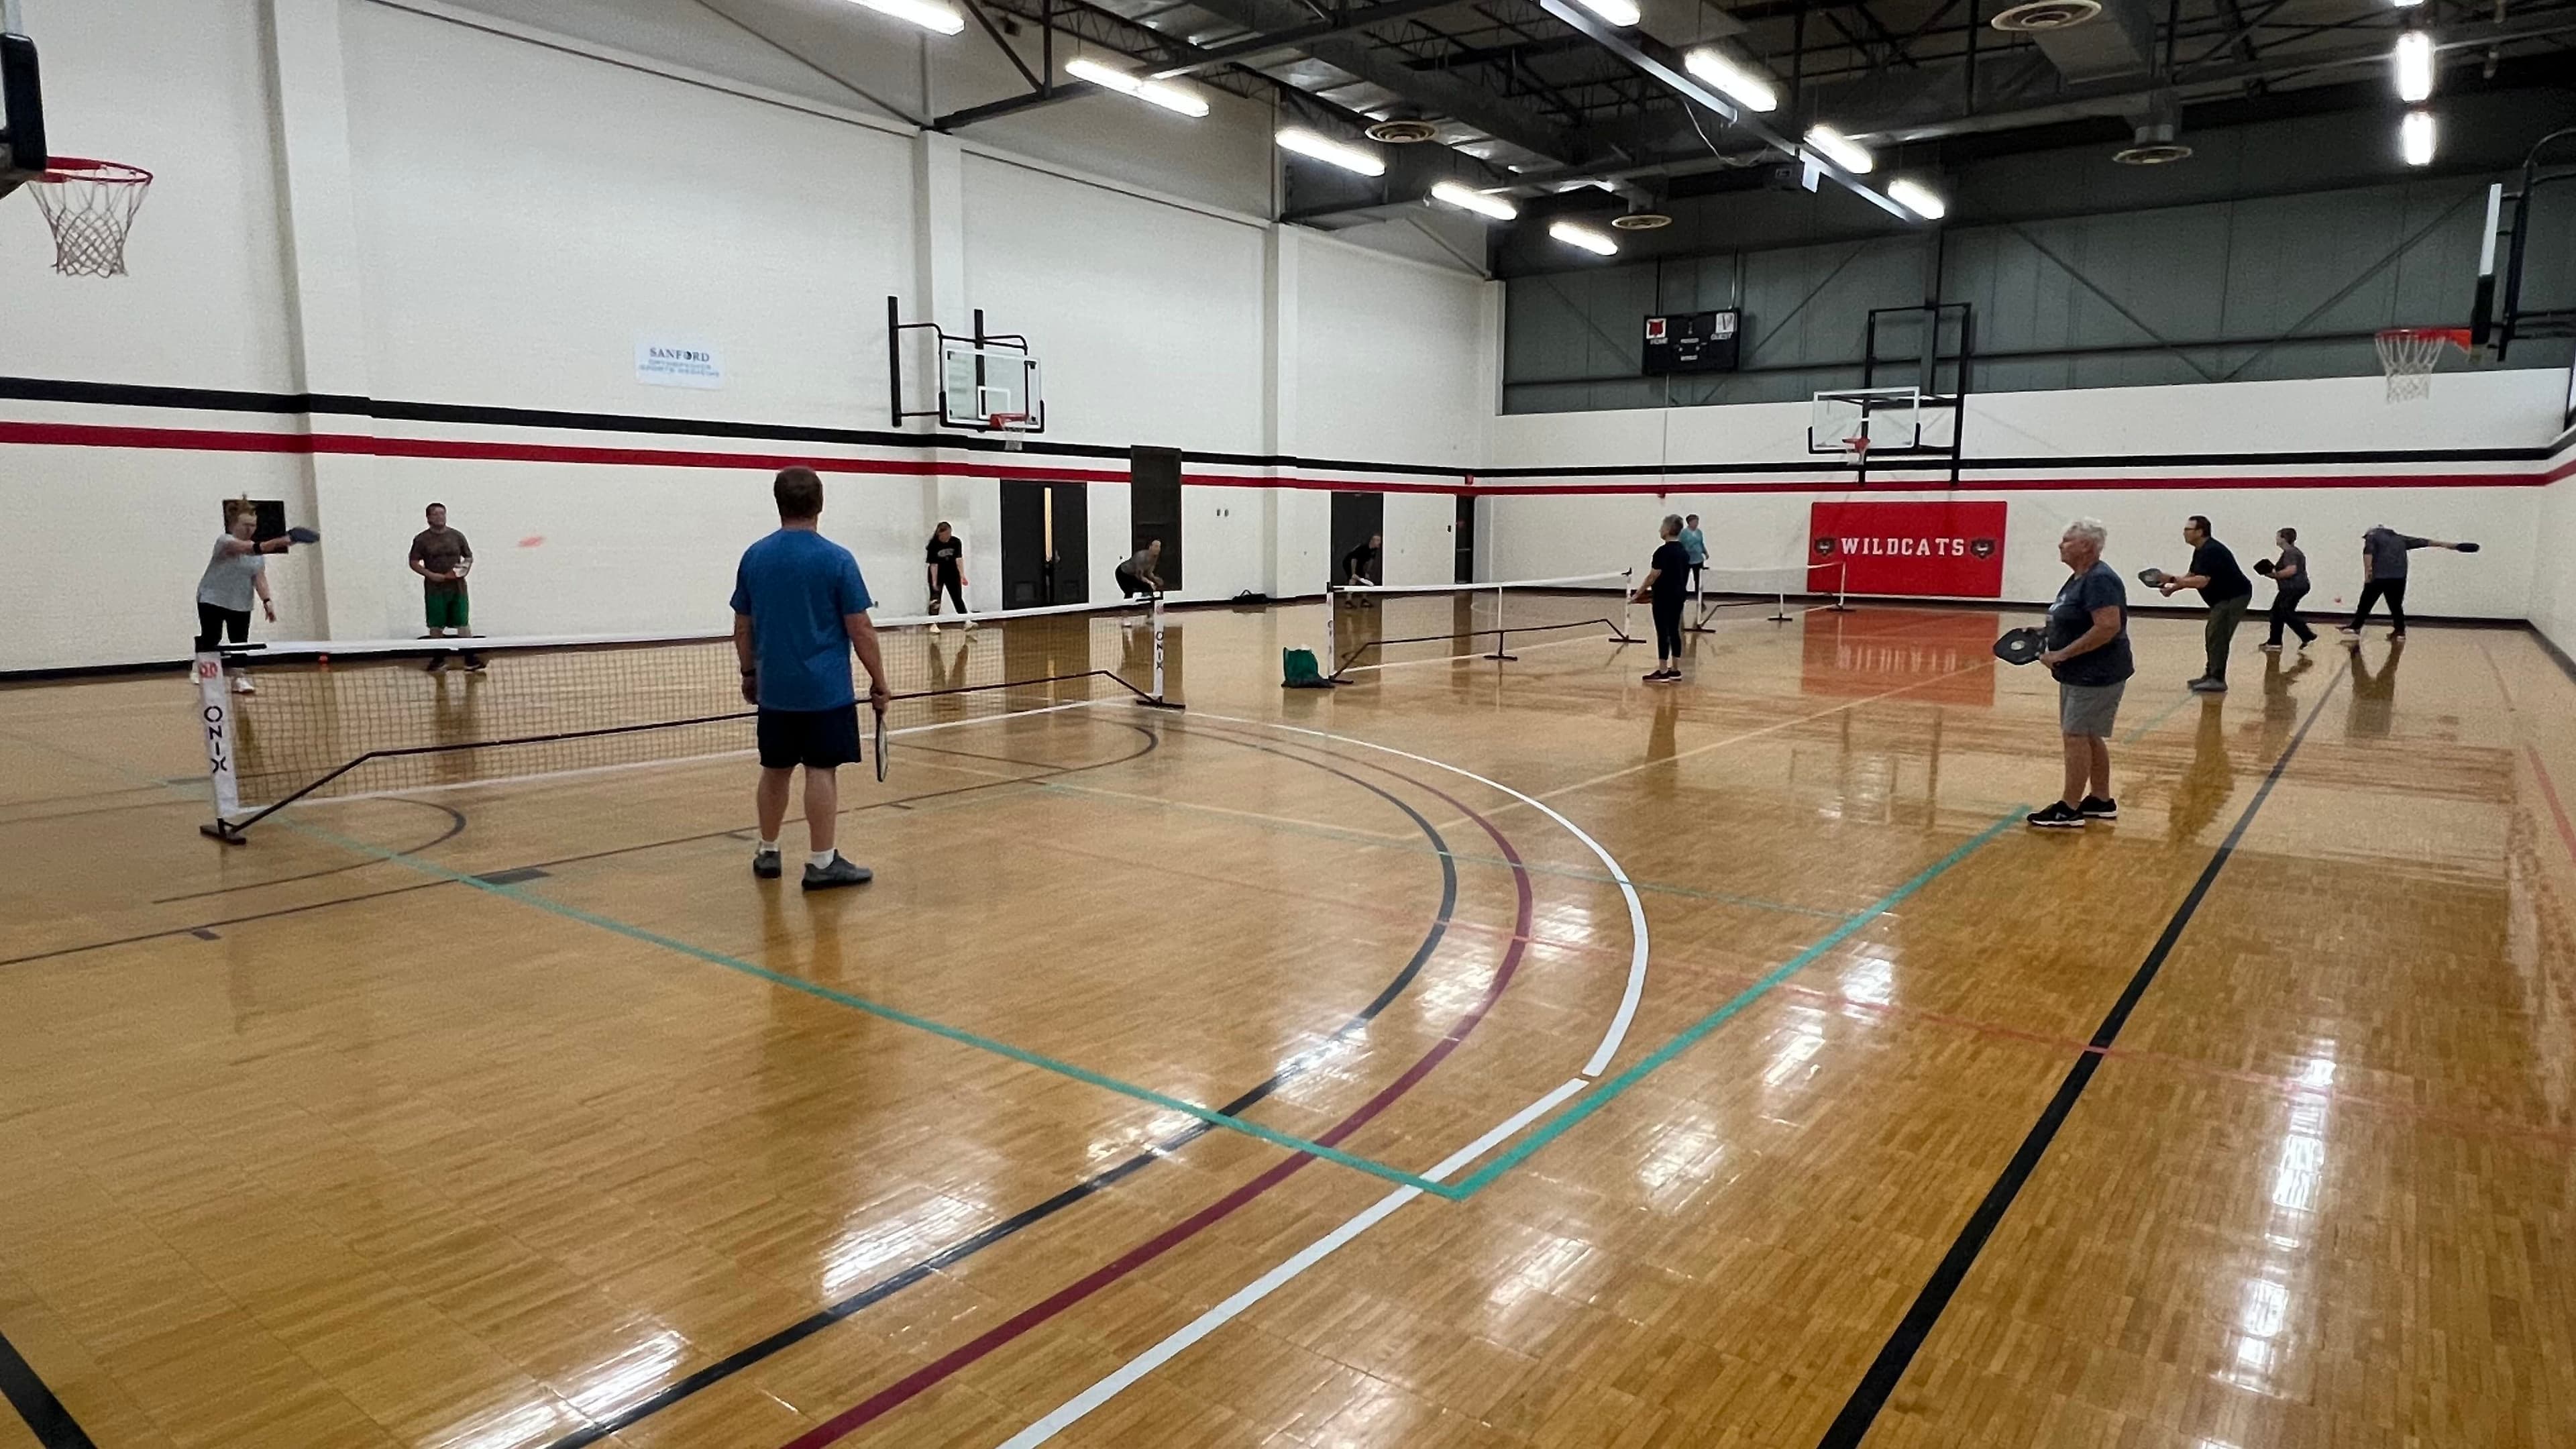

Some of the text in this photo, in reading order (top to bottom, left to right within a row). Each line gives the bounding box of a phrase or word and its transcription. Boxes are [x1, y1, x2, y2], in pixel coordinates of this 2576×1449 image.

[649, 348, 710, 362] SANFORD
[1841, 538, 1964, 556] WILDCATS
[204, 706, 227, 773] ONIX
